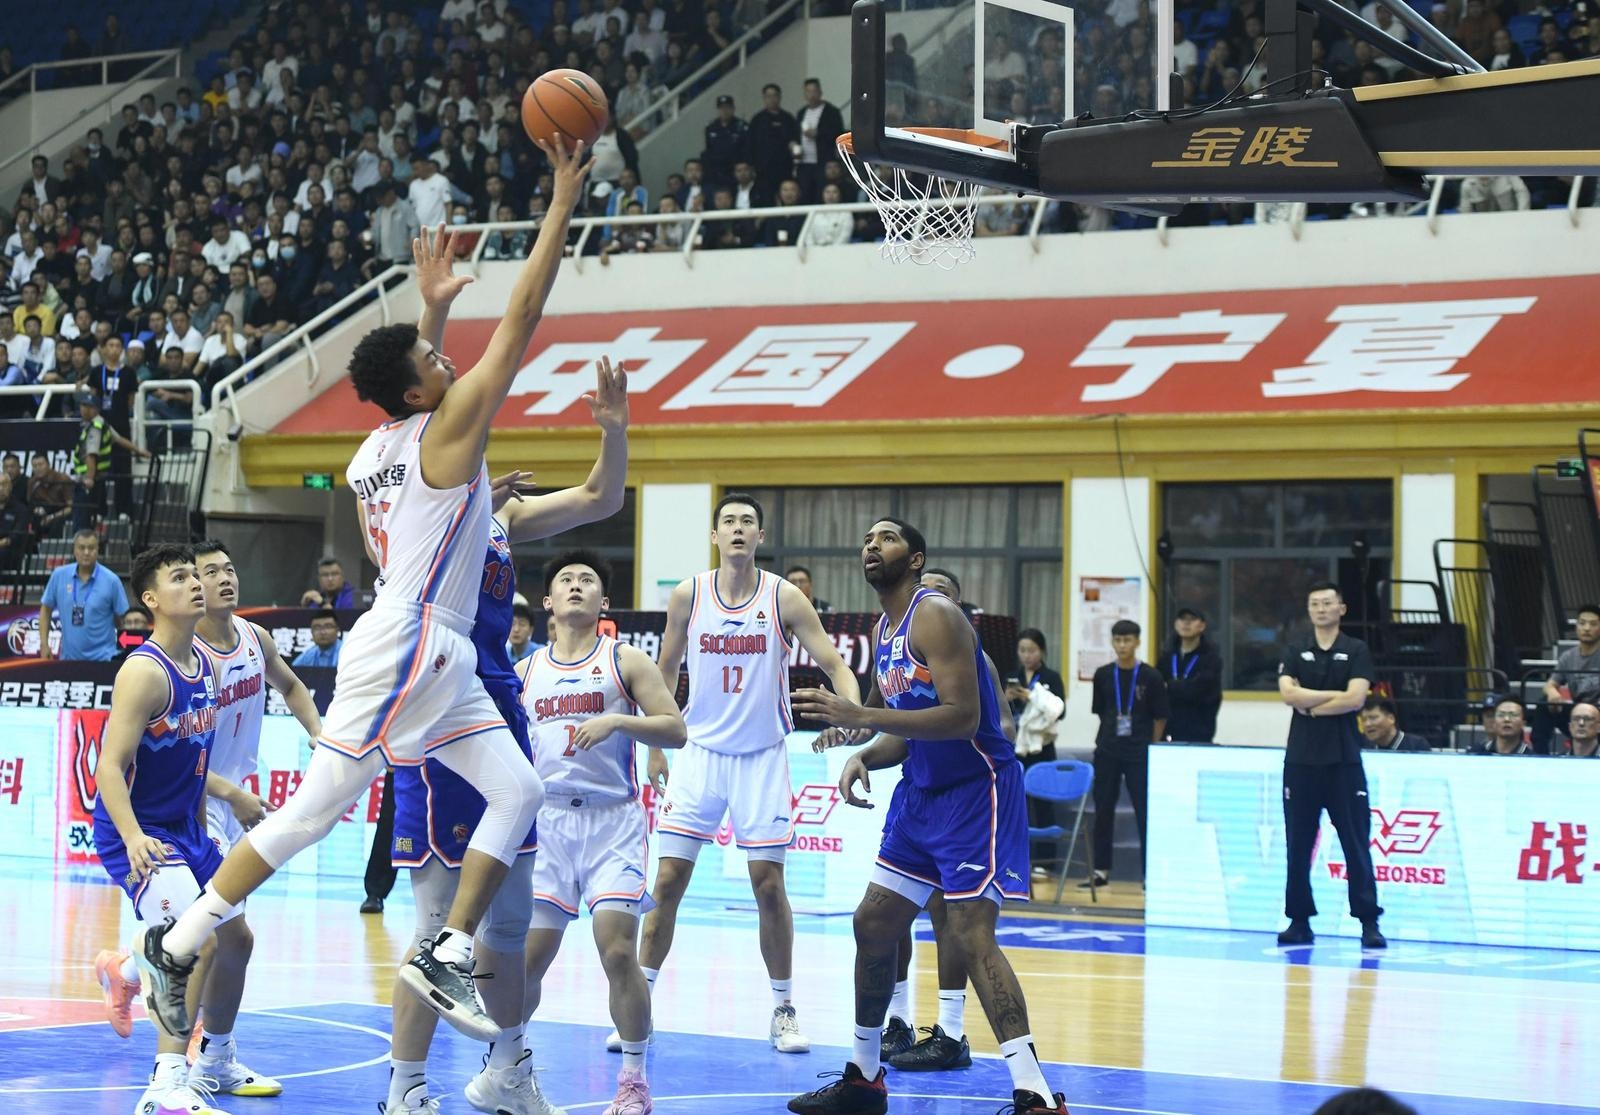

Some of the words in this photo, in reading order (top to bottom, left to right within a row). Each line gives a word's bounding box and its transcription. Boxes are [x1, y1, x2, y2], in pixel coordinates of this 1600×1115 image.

[1151, 126, 1339, 168] 金陵
[482, 560, 512, 600] 13
[699, 633, 767, 655] SICHUAN
[722, 666, 743, 693] 12
[535, 692, 605, 721] SICHUAN
[233, 712, 241, 738] 1
[562, 724, 576, 757] 2
[194, 749, 206, 776] 4
